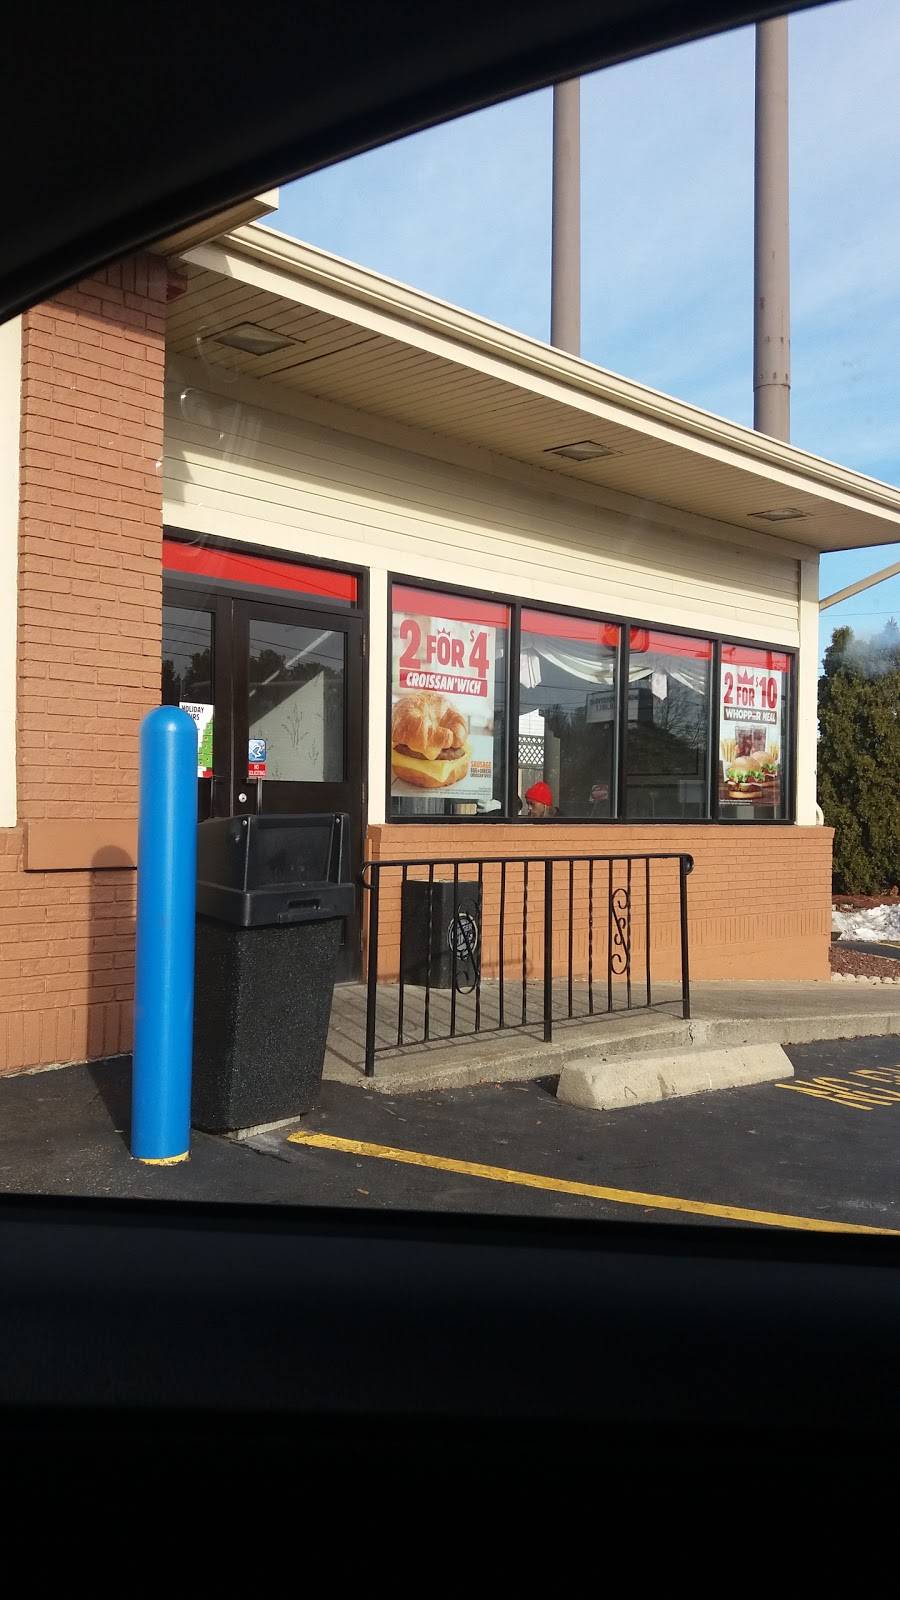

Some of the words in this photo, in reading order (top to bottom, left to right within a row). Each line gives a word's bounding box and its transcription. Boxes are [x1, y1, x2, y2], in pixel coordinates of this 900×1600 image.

[399, 619, 421, 669] 2
[427, 633, 465, 668] FOR
[469, 628, 489, 678] $4
[406, 672, 481, 694] CROISSAN'WICH
[723, 671, 734, 704] 2
[736, 686, 755, 707] FOR
[755, 676, 778, 709] $10
[182, 705, 204, 713] HOLIDAY
